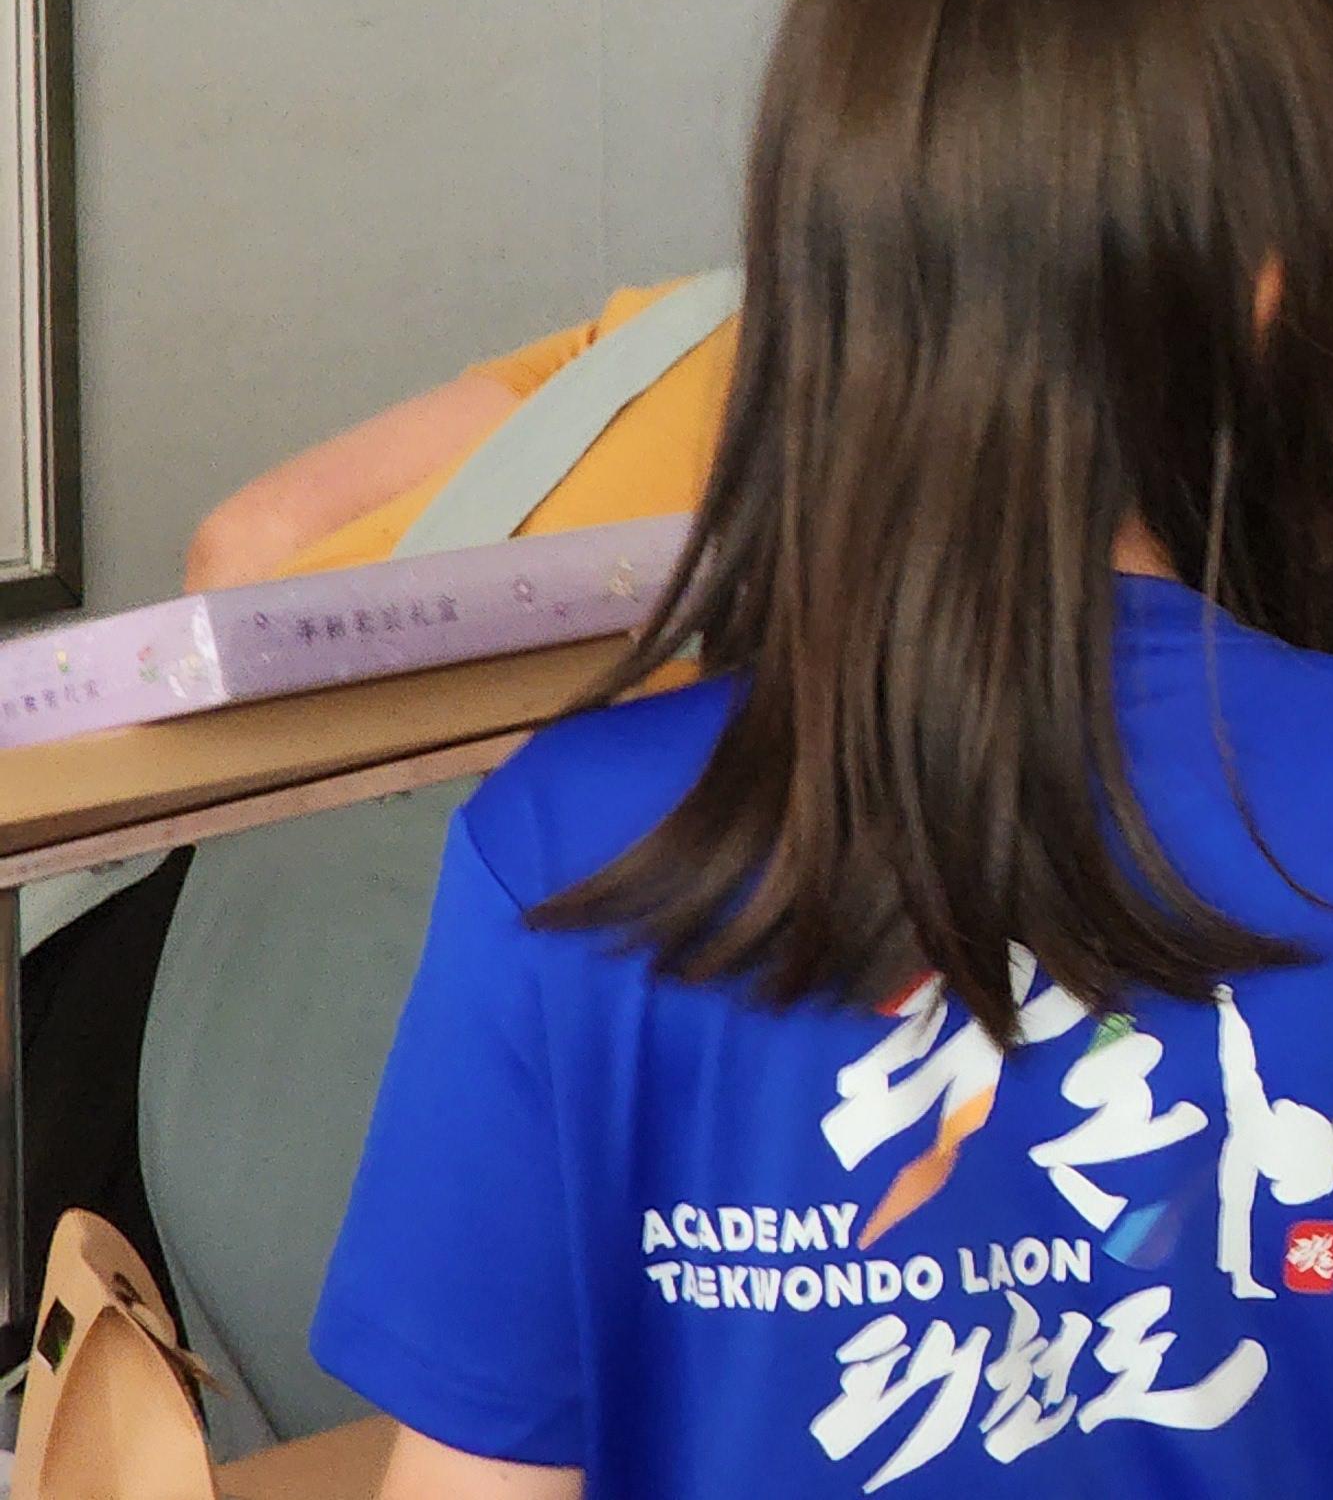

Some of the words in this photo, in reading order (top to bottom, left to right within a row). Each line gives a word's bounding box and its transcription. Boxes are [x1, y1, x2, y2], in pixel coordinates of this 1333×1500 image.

[641, 1201, 859, 1254] ACADEMY
[645, 1254, 944, 1312] TAEKWONDO
[957, 1236, 1092, 1295] LAON
